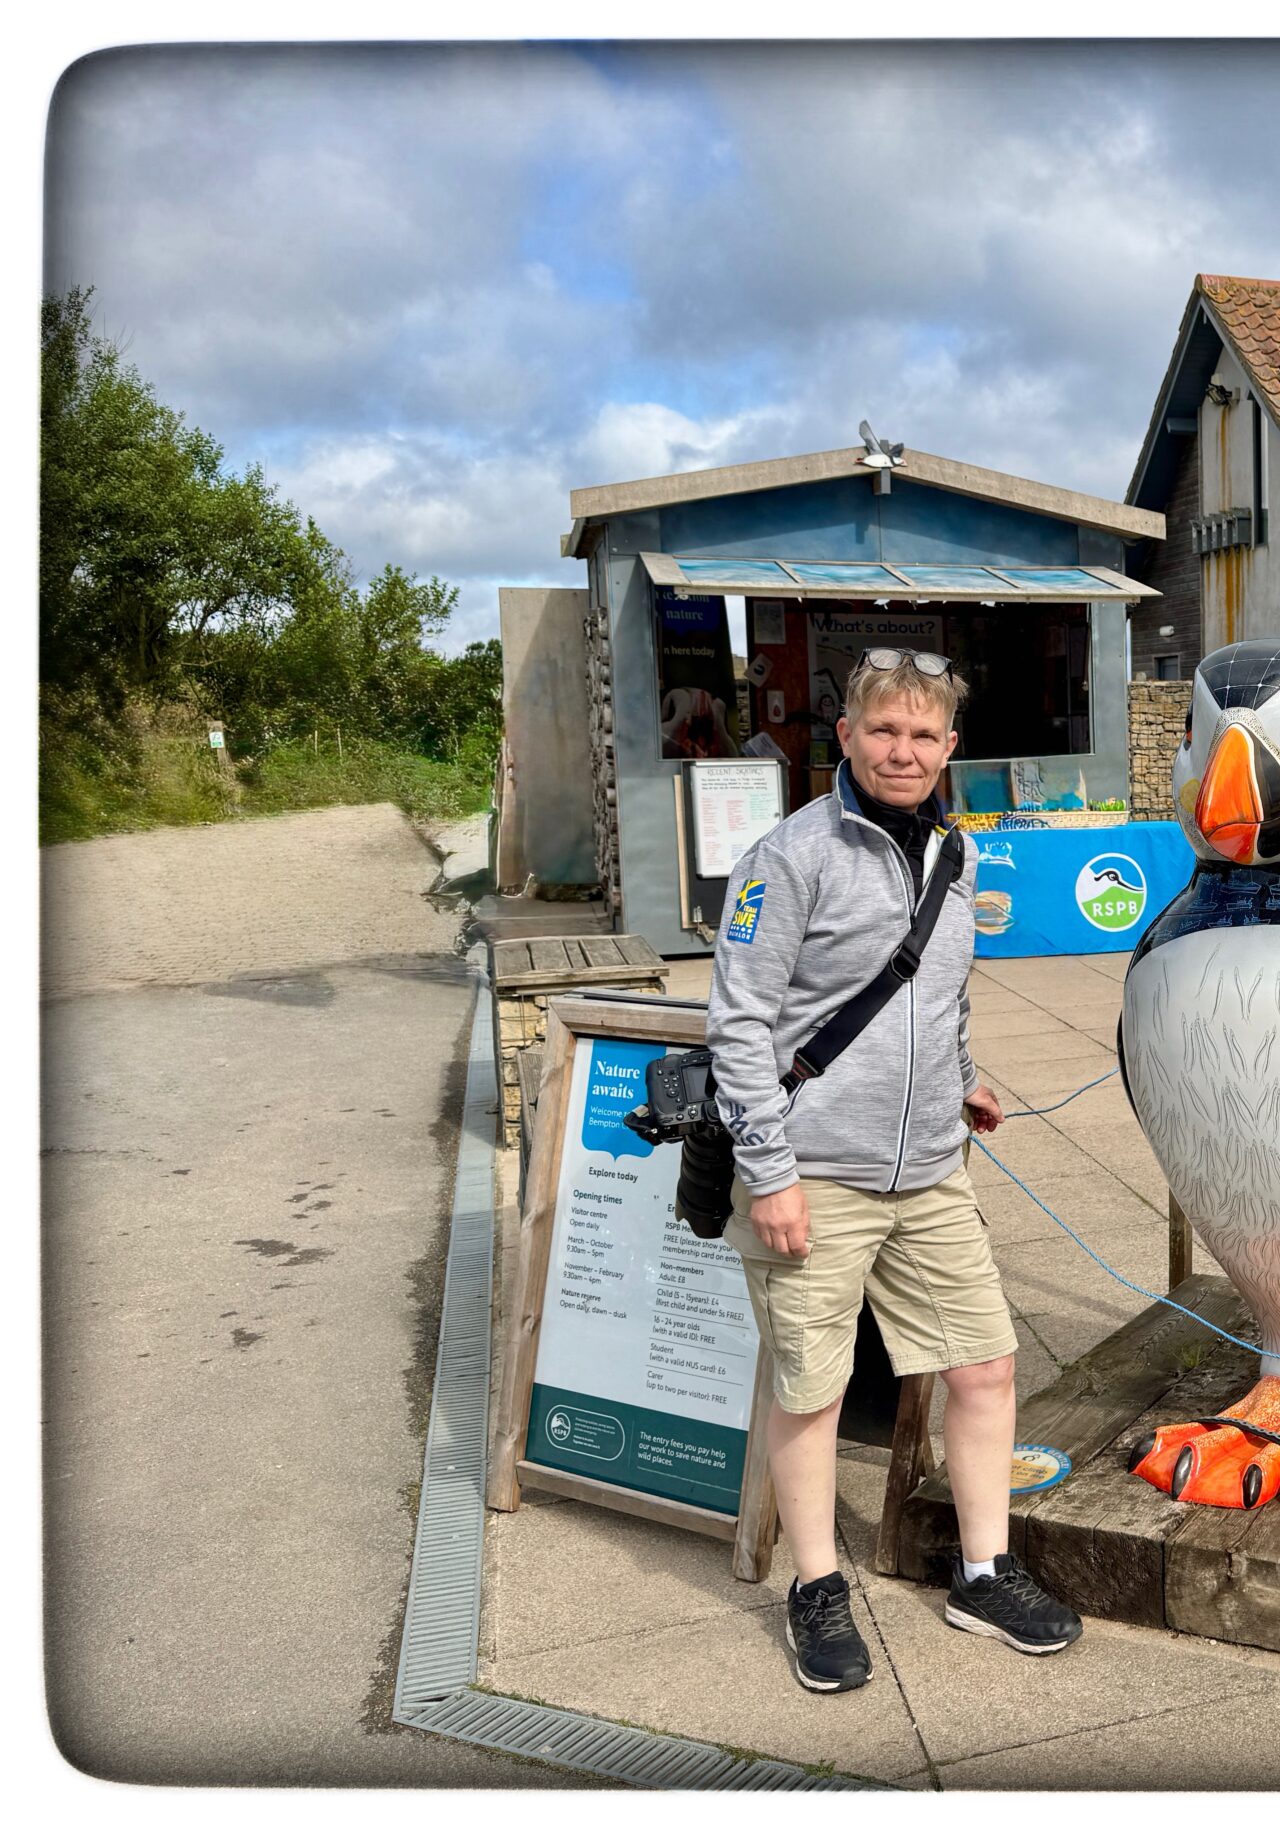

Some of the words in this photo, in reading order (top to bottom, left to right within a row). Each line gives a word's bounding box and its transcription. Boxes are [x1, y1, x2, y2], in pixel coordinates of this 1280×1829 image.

[666, 609, 704, 621] nature
[815, 618, 874, 633] What's
[877, 621, 935, 634] about?
[671, 645, 691, 656] here
[692, 645, 715, 658] today
[1093, 901, 1137, 917] RSPB
[733, 911, 756, 928] SVE
[595, 1060, 640, 1079] Nature
[592, 1083, 634, 1099] awaits
[590, 1106, 621, 1118] Welcome
[589, 1117, 620, 1129] Bempton
[589, 1167, 616, 1179] Explore
[617, 1171, 638, 1183] today
[573, 1189, 602, 1204] Opening
[603, 1195, 622, 1205] times
[571, 1207, 589, 1217] Visitor
[590, 1211, 608, 1219] centre
[570, 1218, 585, 1229] Open
[586, 1220, 600, 1231] daily
[665, 1222, 681, 1231] RSPB
[568, 1235, 585, 1245] March
[590, 1239, 614, 1250] October
[663, 1234, 679, 1243] FREE
[679, 1236, 701, 1248] (please
[702, 1241, 718, 1250] show
[719, 1244, 733, 1253] your
[592, 1249, 604, 1258] 5pm
[662, 1245, 700, 1258] membership
[701, 1250, 715, 1260] card
[565, 1262, 594, 1273] November
[599, 1268, 624, 1280] February
[660, 1262, 704, 1275] Non-members
[588, 1276, 602, 1285] 4pm
[677, 1276, 686, 1284] £8
[561, 1288, 579, 1298] Nature
[580, 1292, 601, 1302] reserve
[657, 1288, 673, 1298] Child
[711, 1298, 719, 1306] £4
[560, 1300, 575, 1309] Open
[592, 1307, 608, 1316] dawn
[613, 1309, 627, 1319] dusk
[656, 1298, 669, 1308] (first
[670, 1301, 685, 1310] child
[686, 1303, 698, 1313] and
[699, 1306, 718, 1316] under
[719, 1310, 725, 1318] 5s
[726, 1312, 744, 1321] FREE)
[654, 1315, 660, 1323] 16
[665, 1317, 672, 1325] 24
[672, 1321, 685, 1329] year
[687, 1322, 700, 1331] olds
[653, 1326, 667, 1335] (with
[673, 1330, 688, 1339] valid
[700, 1335, 716, 1344] FREE
[650, 1343, 674, 1354] Student
[649, 1353, 664, 1363] (with
[670, 1358, 685, 1367] valid
[686, 1360, 699, 1370] NUS
[700, 1363, 717, 1374] card):
[717, 1366, 726, 1375] £6
[647, 1371, 663, 1380] Carer
[646, 1380, 656, 1390] (up
[657, 1383, 664, 1391] to
[664, 1385, 676, 1393] two
[676, 1388, 688, 1396] per
[689, 1389, 710, 1401] visitor):
[711, 1394, 728, 1404] FREE
[553, 1427, 567, 1437] RSPB
[640, 1431, 651, 1442] The
[652, 1435, 670, 1447] entry
[670, 1438, 684, 1449] fees
[684, 1442, 697, 1453] you
[698, 1446, 710, 1457] pay
[711, 1448, 726, 1460] help
[638, 1442, 650, 1450] our
[651, 1444, 667, 1456] work
[668, 1447, 675, 1456] to
[676, 1451, 689, 1460] save
[691, 1453, 711, 1466] nature
[713, 1460, 726, 1469] and
[638, 1451, 651, 1462] wild
[652, 1454, 673, 1467] places.
